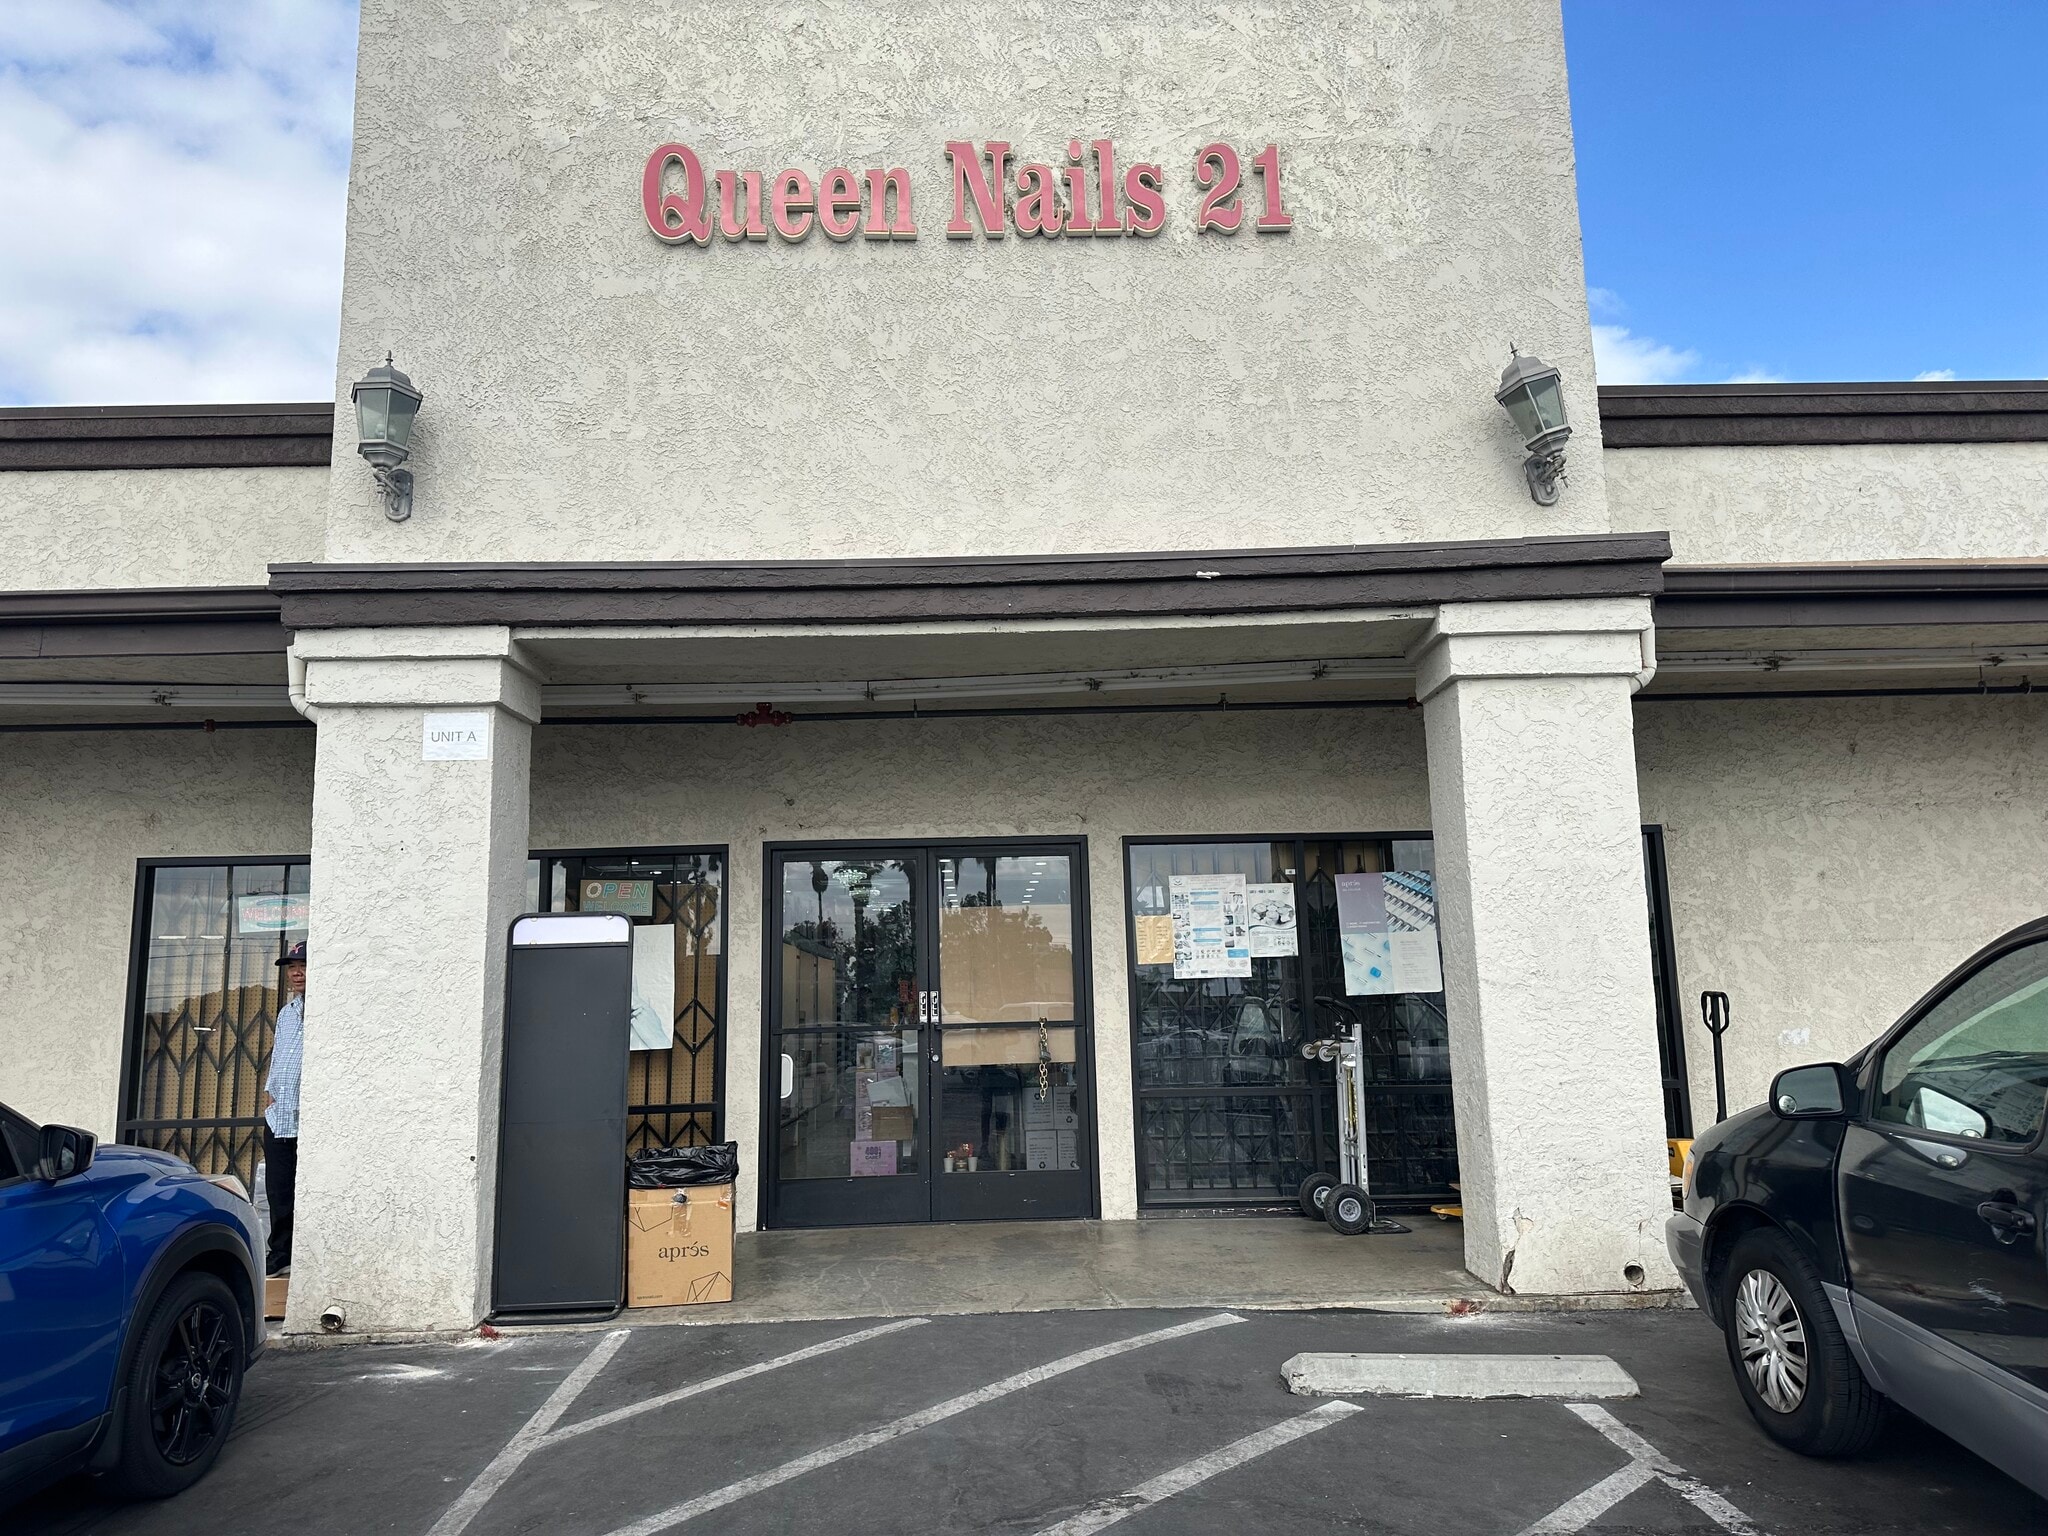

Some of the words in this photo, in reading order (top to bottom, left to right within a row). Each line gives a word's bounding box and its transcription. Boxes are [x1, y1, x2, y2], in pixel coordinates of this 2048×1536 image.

[642, 143, 918, 247] Queen
[944, 140, 1166, 239] Nails
[1197, 143, 1293, 235] 21
[431, 731, 463, 742] UNIT
[467, 731, 477, 742] A
[586, 882, 648, 898] OPEN
[583, 901, 649, 912] WELCOME
